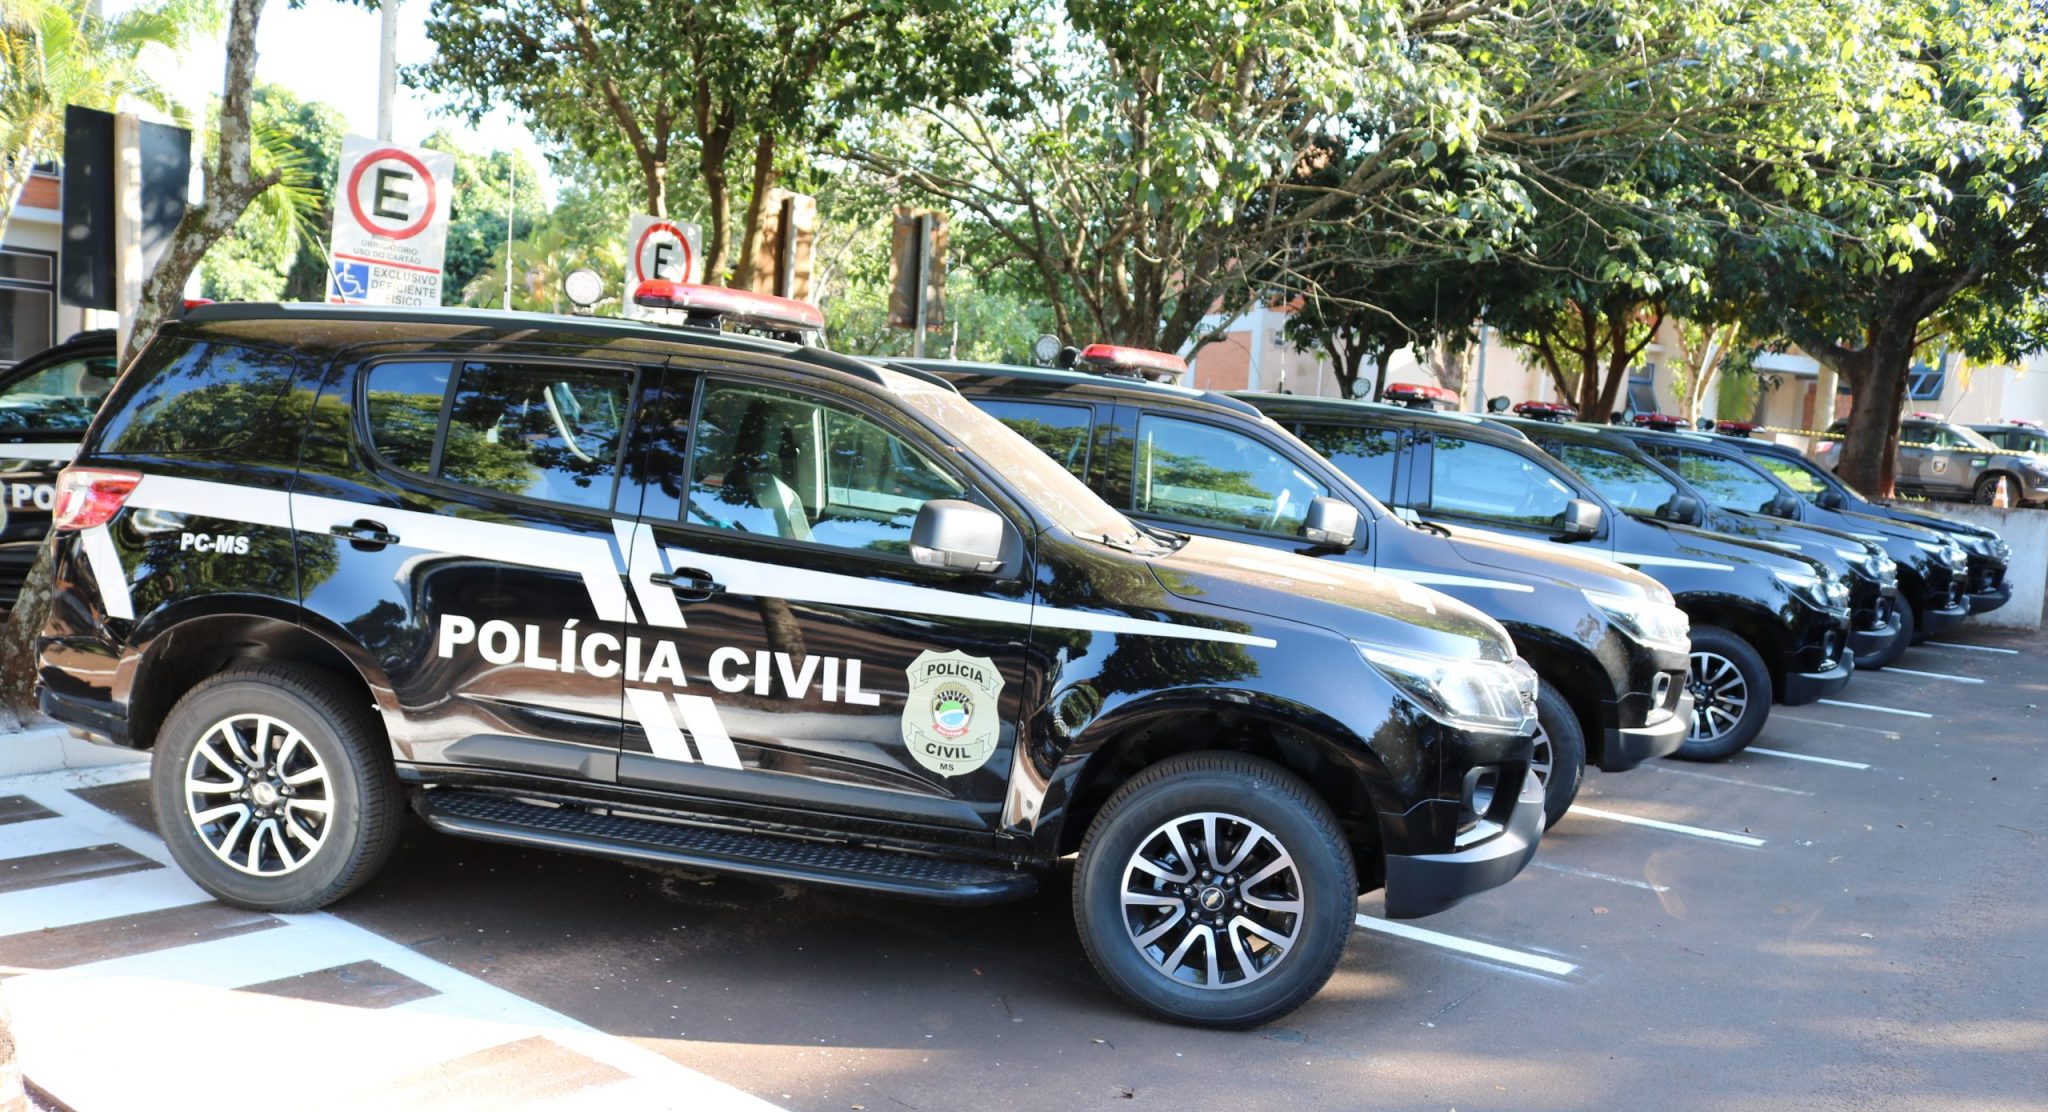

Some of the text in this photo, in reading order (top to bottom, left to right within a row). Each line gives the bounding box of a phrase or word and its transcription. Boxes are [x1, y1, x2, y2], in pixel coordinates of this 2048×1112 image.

[373, 167, 413, 221] E
[353, 248, 371, 256] USO
[373, 251, 385, 259] DO
[373, 267, 437, 286] EXCLUSIVO
[180, 533, 249, 555] PC-MS
[438, 614, 881, 706] POLÍCIA CIVIL
[927, 662, 983, 683] POLÍCIA
[925, 743, 971, 759] CIVIL
[940, 763, 954, 771] MS
